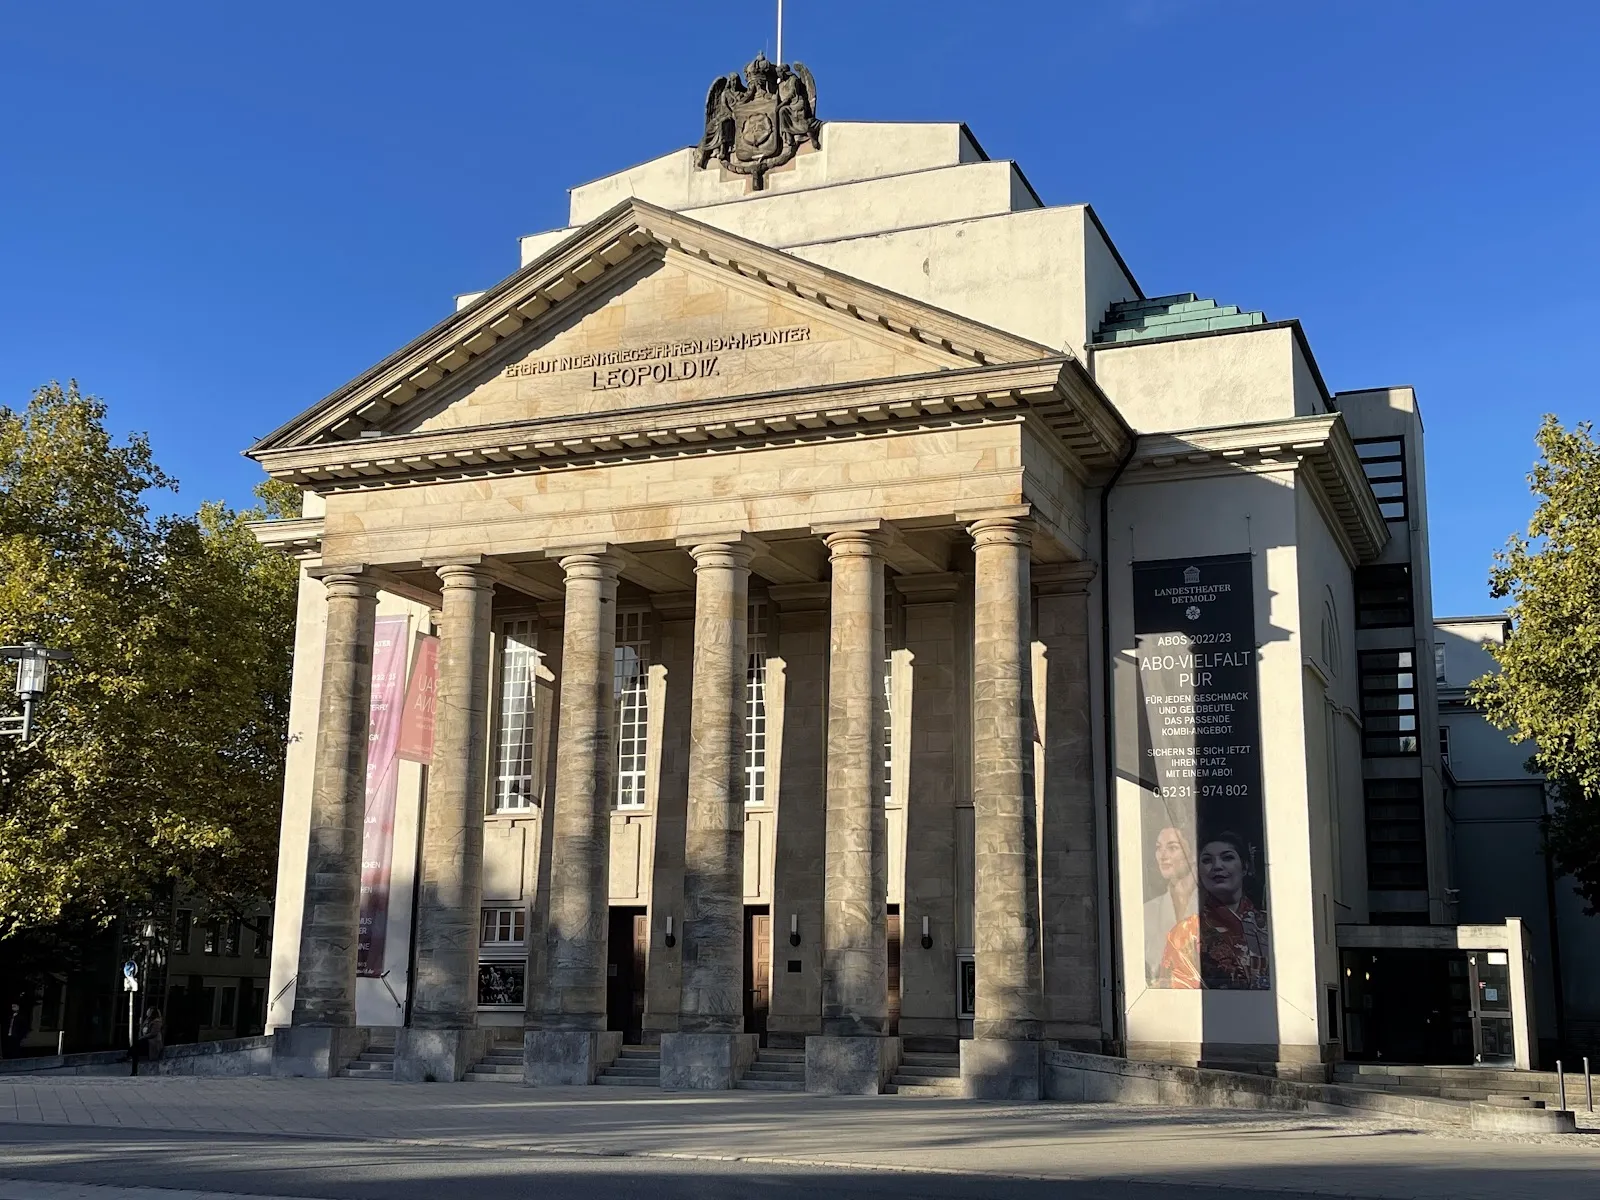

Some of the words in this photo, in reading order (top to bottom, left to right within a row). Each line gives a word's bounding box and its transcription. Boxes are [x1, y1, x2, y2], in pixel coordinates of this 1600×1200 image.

[504, 358, 558, 378] ERBAUT
[559, 356, 573, 372] IN
[573, 353, 601, 370] DEN
[601, 340, 703, 366] KRIEGSJAHREN
[760, 327, 811, 346] UNTER
[591, 358, 698, 391] LEOPOLD
[699, 356, 720, 378] IV.
[1154, 583, 1232, 597] LANDESTHEATER
[1171, 593, 1217, 605] DETMOLD
[1157, 635, 1188, 647] ABOS
[1190, 632, 1232, 645] 2022/23
[1140, 651, 1251, 671] ABO-VIELFALT
[1179, 672, 1213, 688] PUR
[1145, 694, 1163, 705] FÜR
[1164, 694, 1192, 704] JEDEN
[1193, 692, 1249, 703] GESCHMACK
[1158, 705, 1178, 715] UND
[1179, 703, 1236, 714] GELDBEUTEL
[1164, 716, 1183, 726] DAS
[1184, 714, 1231, 725] PASSENDE
[1161, 725, 1234, 736] KOMBI-ANGEBOT.
[1147, 747, 1185, 757] SICHERN
[1187, 746, 1201, 756] SIE
[1203, 745, 1224, 756] SICH
[1226, 745, 1251, 755] JETZT
[1171, 758, 1198, 767] IHREN
[1200, 757, 1227, 766] PLATZ
[1165, 769, 1181, 778] MIT
[1182, 768, 1210, 778] EINEM
[1211, 767, 1233, 777] ABO!
